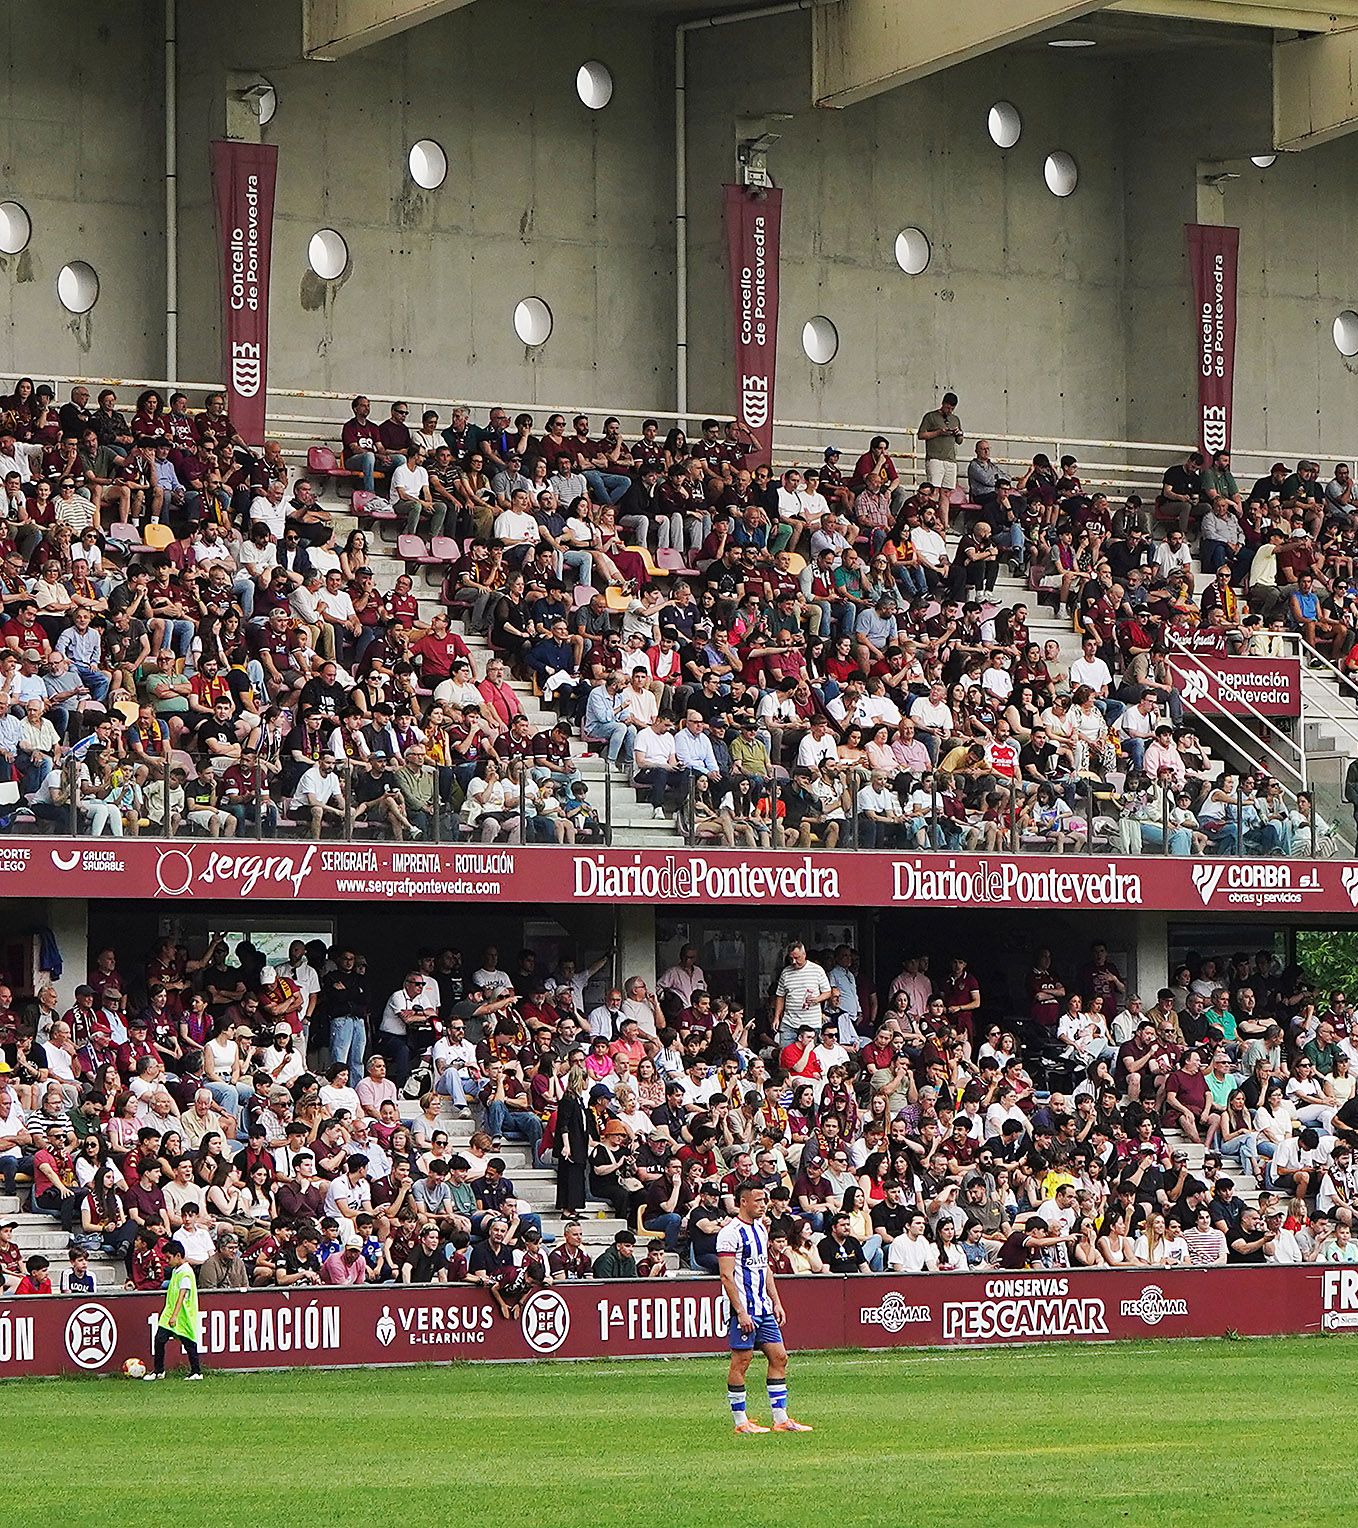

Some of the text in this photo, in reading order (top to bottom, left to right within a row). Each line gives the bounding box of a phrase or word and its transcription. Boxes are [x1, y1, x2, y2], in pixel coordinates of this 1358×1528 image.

[246, 175, 258, 311] de Pontevedra
[231, 228, 244, 310] Concello
[754, 217, 766, 346] de Pontevedra
[741, 268, 752, 345] Concello
[1213, 255, 1224, 378] de Pontevedra
[1202, 303, 1212, 377] Concello
[1217, 671, 1289, 689] Deputación
[1217, 688, 1290, 703] Pontevedra
[82, 861, 125, 872] SAUDABLE
[83, 851, 115, 861] GALICIA
[321, 849, 378, 872] SERIGRAFÍA
[392, 853, 441, 873] IMPRENTA
[455, 851, 514, 874] ROTULACIÓN
[198, 845, 317, 897] sergraf
[1228, 865, 1290, 888] CORBA
[336, 878, 500, 897] www.sergrafpontevedra.com
[1228, 893, 1302, 906] obras y servicios
[985, 1278, 1069, 1298] CONSERVAS
[398, 1305, 494, 1331] VERSUS
[861, 1305, 932, 1323] PESCAMAR
[943, 1298, 1109, 1339] PESCAMAR
[1120, 1298, 1189, 1316] PESCAMAR
[182, 1299, 341, 1355] EDERACIÓN
[409, 1331, 485, 1345] E-LEARNING
